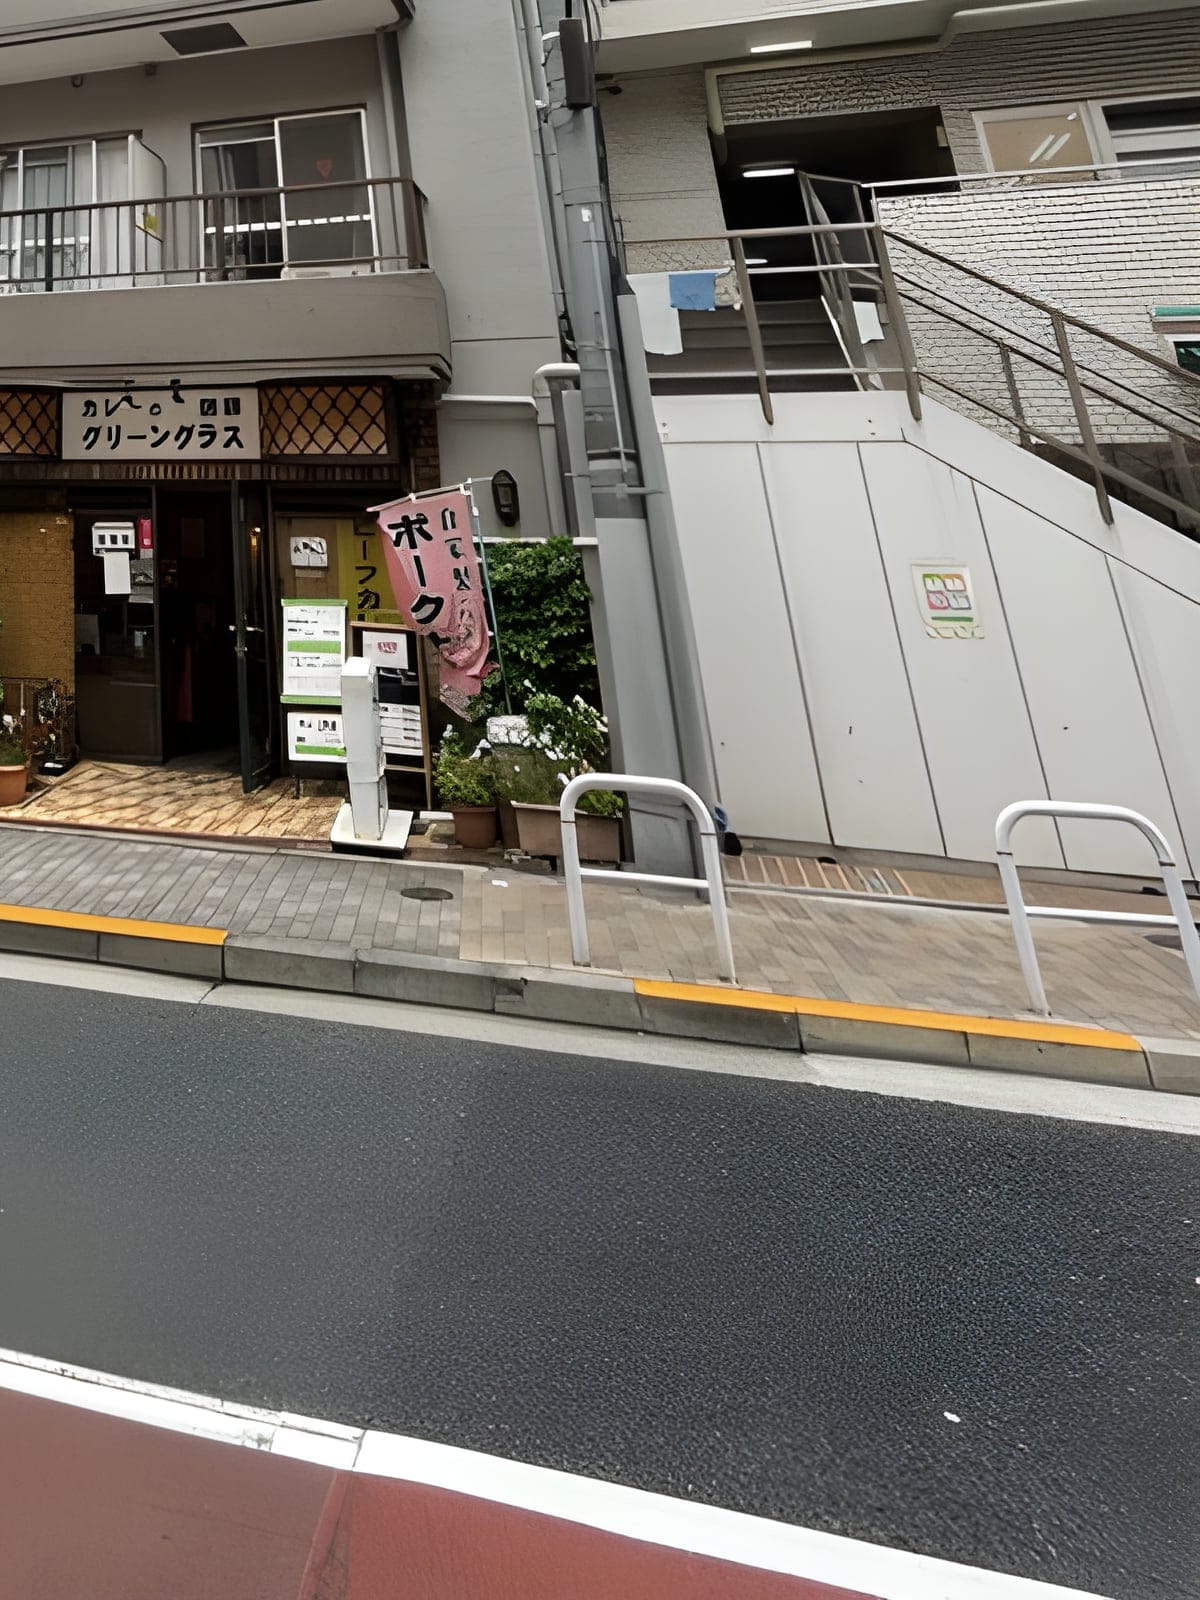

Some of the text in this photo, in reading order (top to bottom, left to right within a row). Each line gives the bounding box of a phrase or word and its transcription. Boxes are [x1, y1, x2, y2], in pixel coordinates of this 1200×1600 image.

[82, 423, 244, 450] グリーングラス
[387, 512, 450, 649] ポーク
